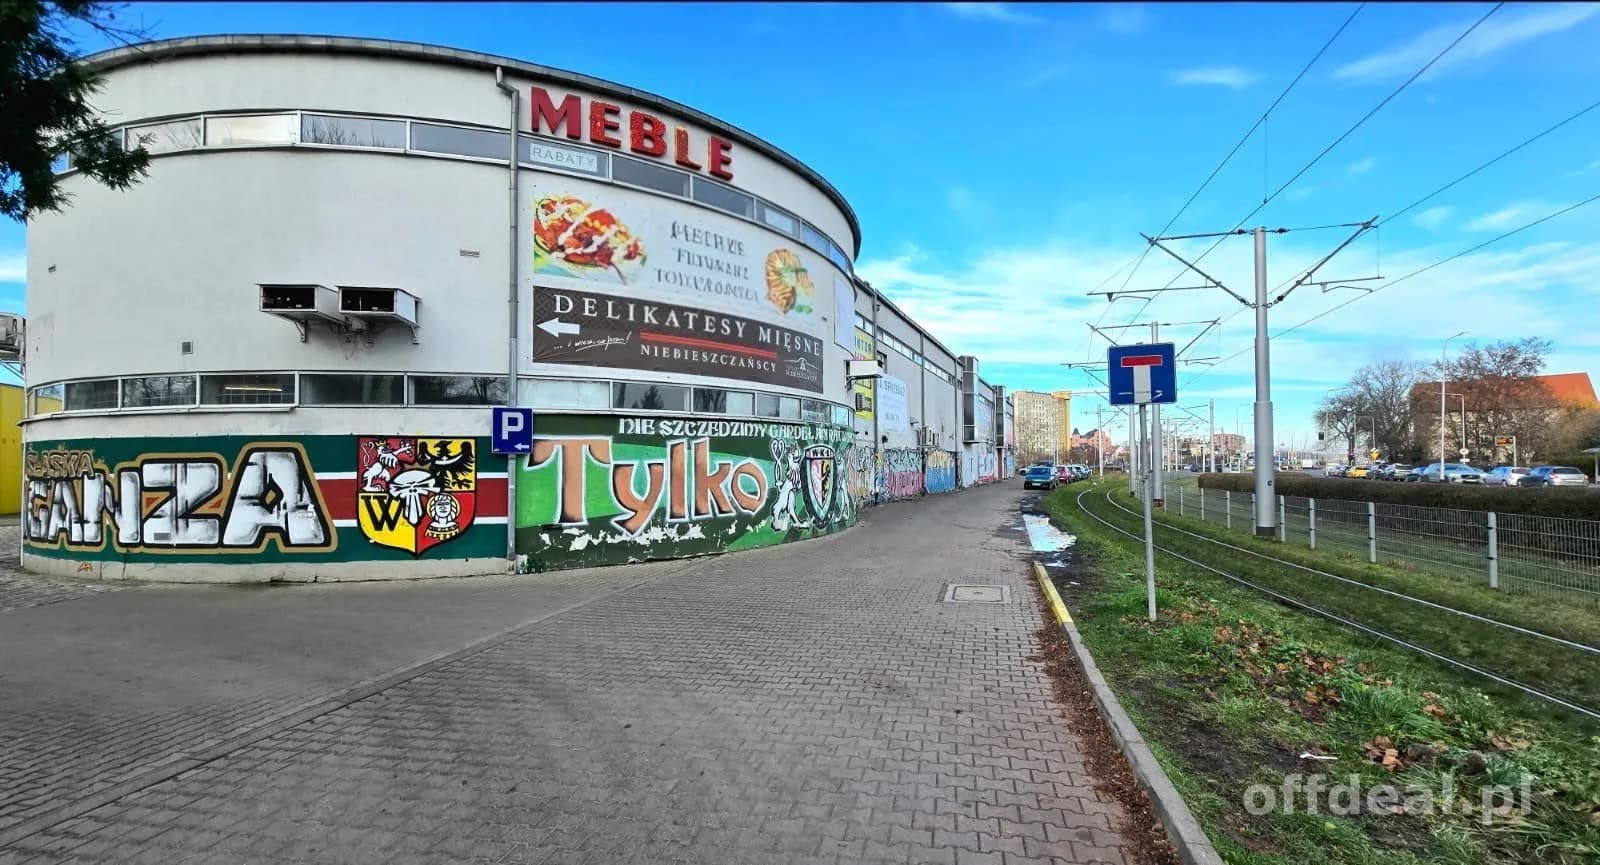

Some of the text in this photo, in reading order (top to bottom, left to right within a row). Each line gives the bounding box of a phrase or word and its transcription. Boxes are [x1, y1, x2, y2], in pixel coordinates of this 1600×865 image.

[531, 86, 734, 181] MEBLE
[533, 147, 595, 166] RABATY
[553, 294, 746, 338] DELIKATESY
[759, 325, 820, 356] MIĘSNE
[640, 344, 777, 372] NIEBIESZCZAŃSCY
[502, 411, 523, 440] P
[619, 418, 655, 435] NIE
[527, 437, 768, 537] Tylko
